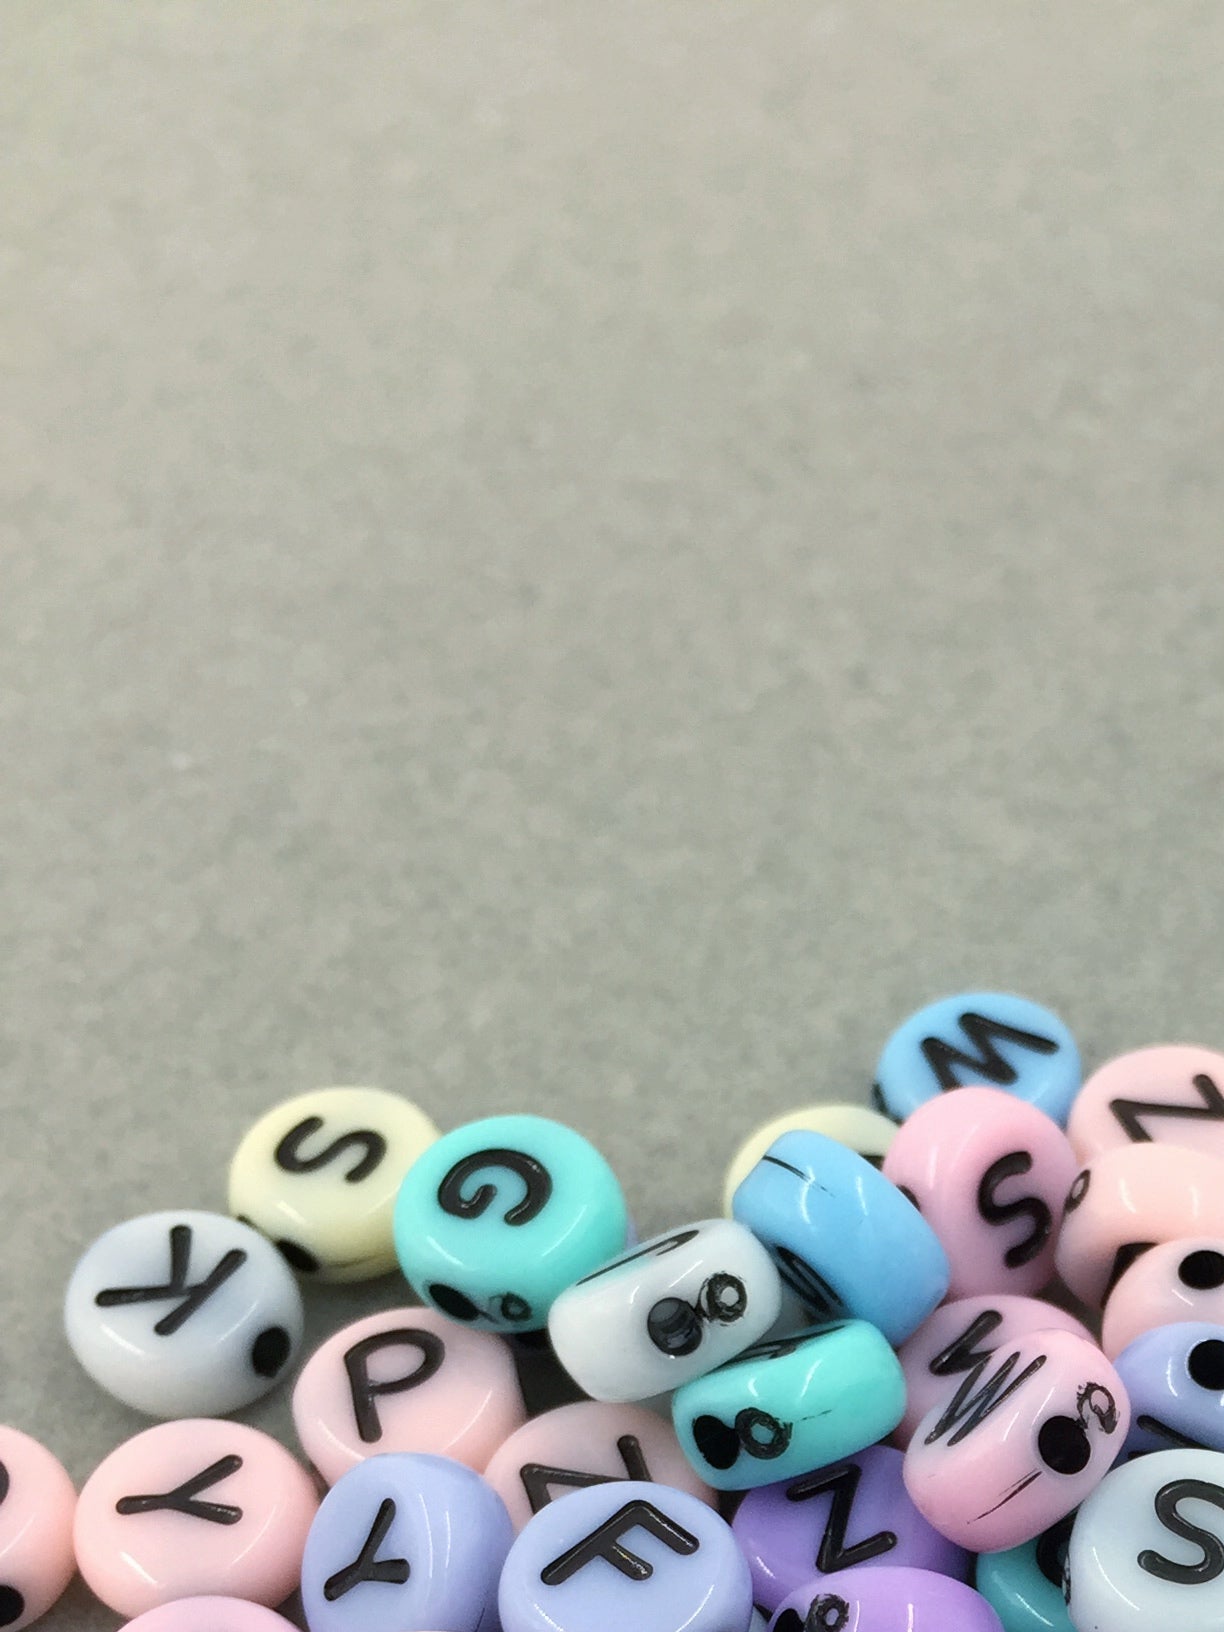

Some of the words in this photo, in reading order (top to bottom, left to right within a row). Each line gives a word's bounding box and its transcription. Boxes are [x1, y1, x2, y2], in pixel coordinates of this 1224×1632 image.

[275, 1115, 387, 1184] S
[438, 1148, 552, 1226] G
[977, 1150, 1051, 1269] S
[95, 1225, 247, 1336] K
[345, 1327, 446, 1443] P
[115, 1453, 243, 1525] Y
[322, 1497, 410, 1602] Y
[540, 1499, 700, 1586] F
